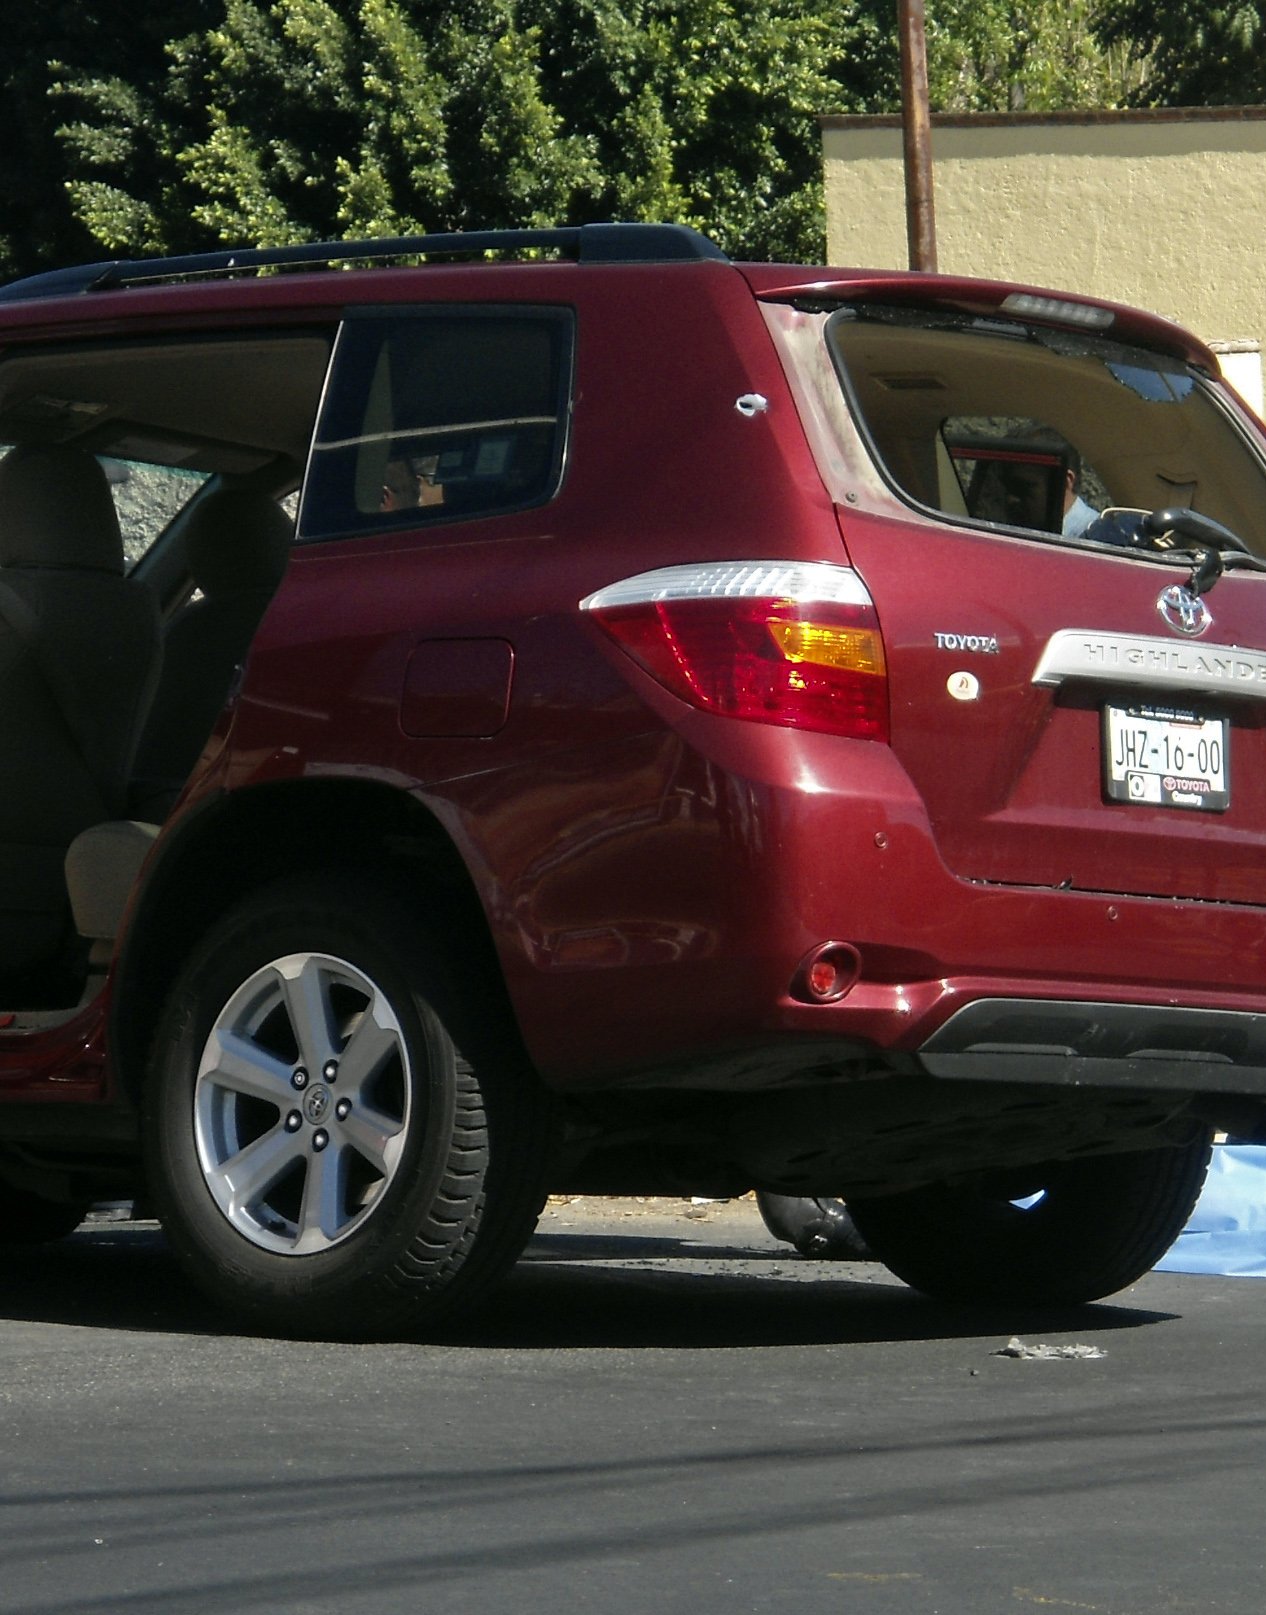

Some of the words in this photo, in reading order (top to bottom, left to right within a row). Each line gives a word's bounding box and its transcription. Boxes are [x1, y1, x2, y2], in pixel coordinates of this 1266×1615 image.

[934, 632, 999, 654] TOYOTA
[1115, 728, 1220, 775] JHZ-16-00
[1175, 779, 1211, 793] TOYOTA
